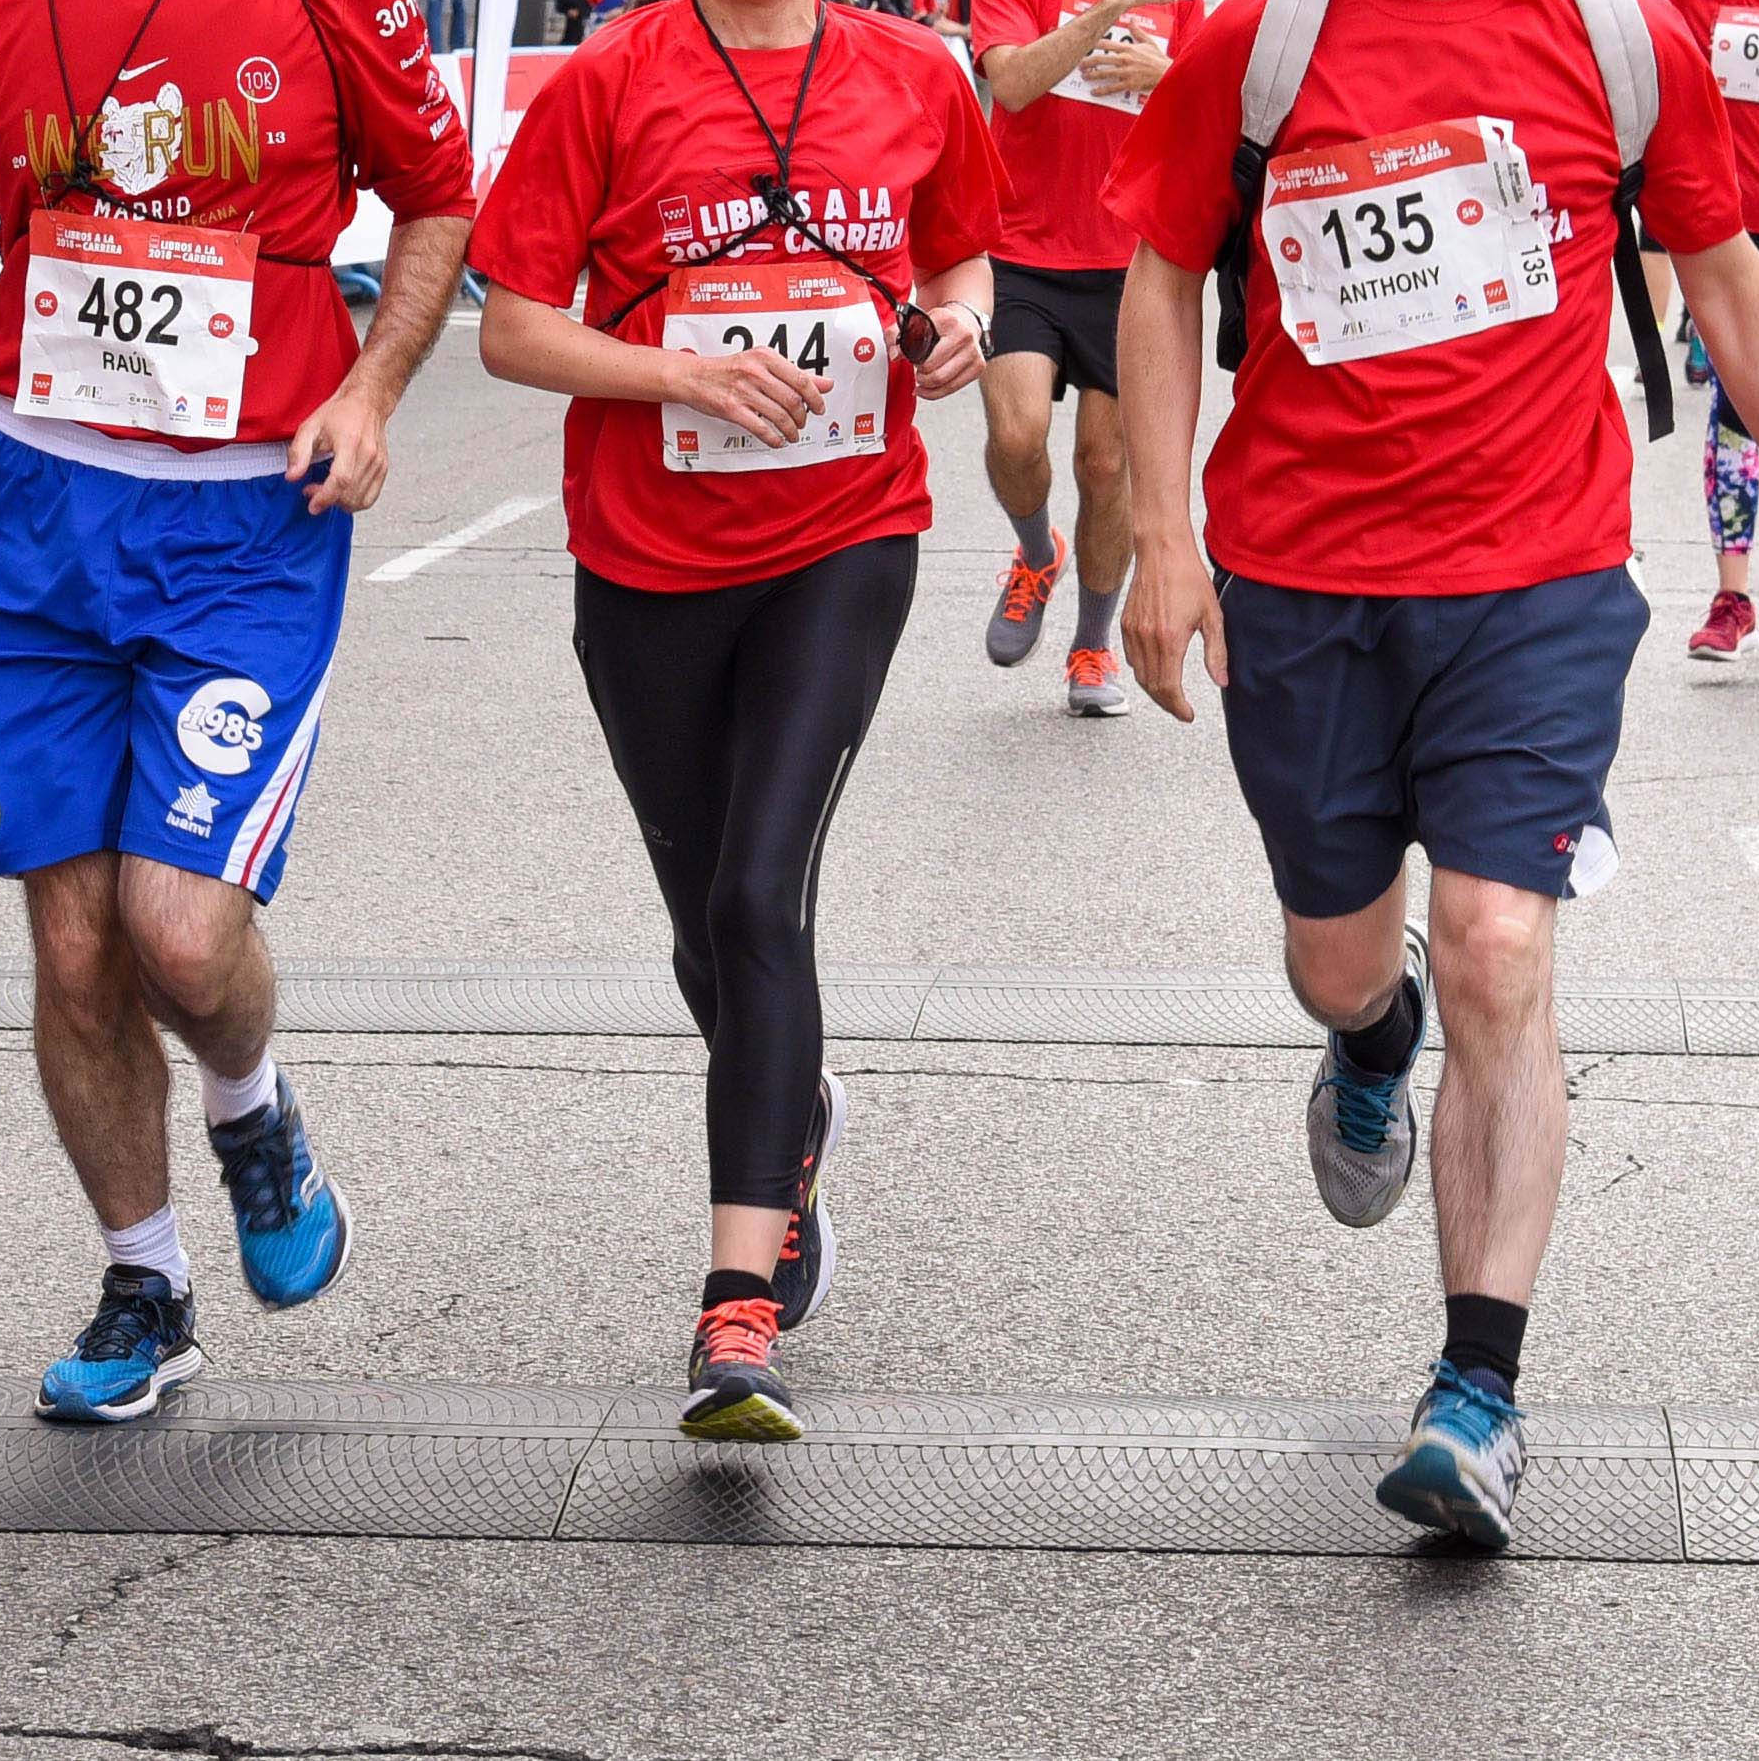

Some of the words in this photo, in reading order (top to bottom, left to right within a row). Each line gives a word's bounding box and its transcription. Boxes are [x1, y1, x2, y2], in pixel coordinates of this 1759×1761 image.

[244, 71, 274, 90] 10K
[144, 89, 260, 184] RUN
[265, 131, 287, 145] 13
[93, 195, 192, 222] MADRID
[699, 190, 812, 237] LIBRS
[824, 188, 848, 221] A
[859, 187, 892, 220] LA
[64, 229, 92, 243] LIBROS
[94, 233, 102, 243] A
[103, 234, 115, 244] LA
[1321, 192, 1435, 270] 135
[160, 240, 192, 254] LIBROS
[194, 244, 203, 254] A
[204, 245, 216, 256] LA
[1520, 243, 1550, 287] 135
[698, 282, 730, 293] LIBROS
[739, 281, 753, 292] LA
[1340, 265, 1441, 306] ANTHONY
[38, 298, 53, 310] 5K
[78, 276, 183, 347] 482
[212, 319, 229, 332] 5K
[857, 344, 872, 355] 5K
[102, 351, 153, 377] RAÚL
[181, 704, 263, 752] 1985
[165, 809, 213, 840] luanvi
